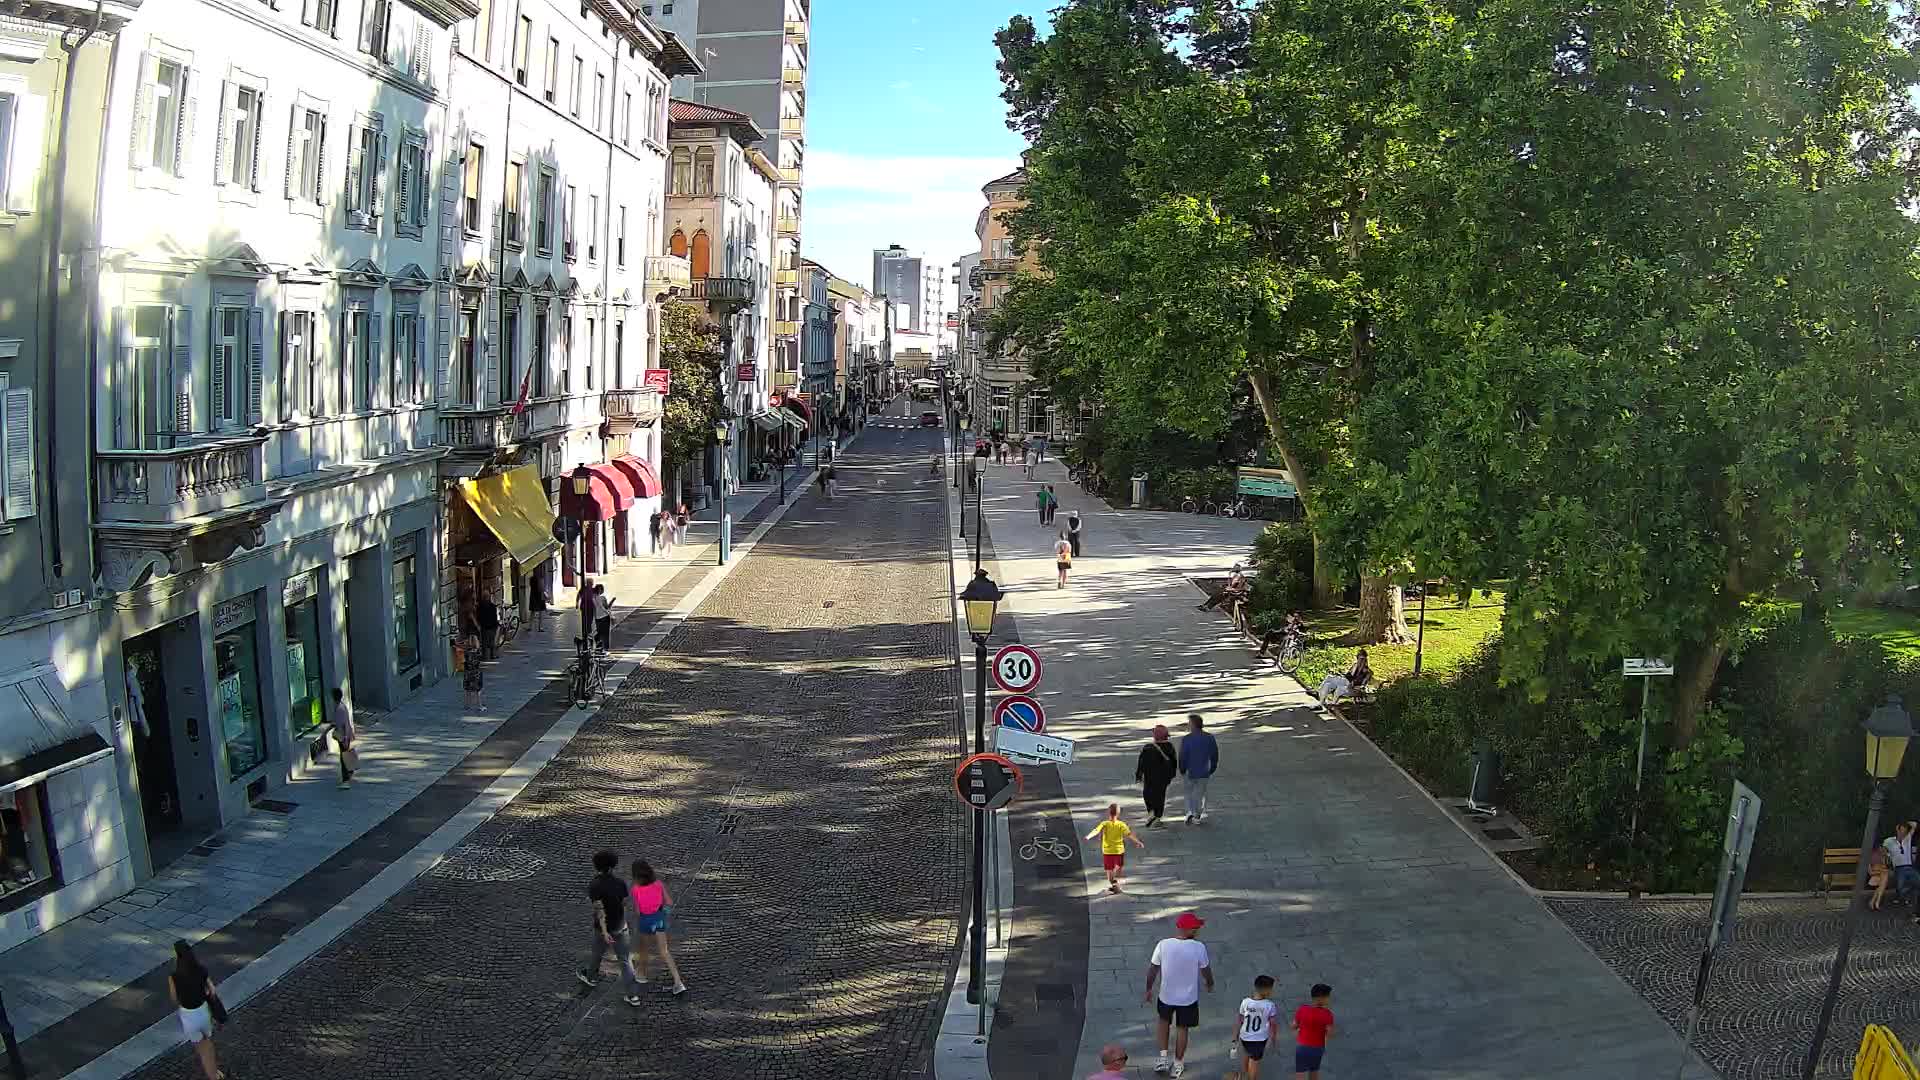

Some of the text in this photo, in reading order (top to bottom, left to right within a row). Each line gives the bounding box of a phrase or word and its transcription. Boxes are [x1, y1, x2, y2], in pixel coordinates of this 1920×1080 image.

[1004, 657, 1031, 680] 30
[1036, 743, 1067, 758] Dante
[1245, 1014, 1261, 1032] 10
